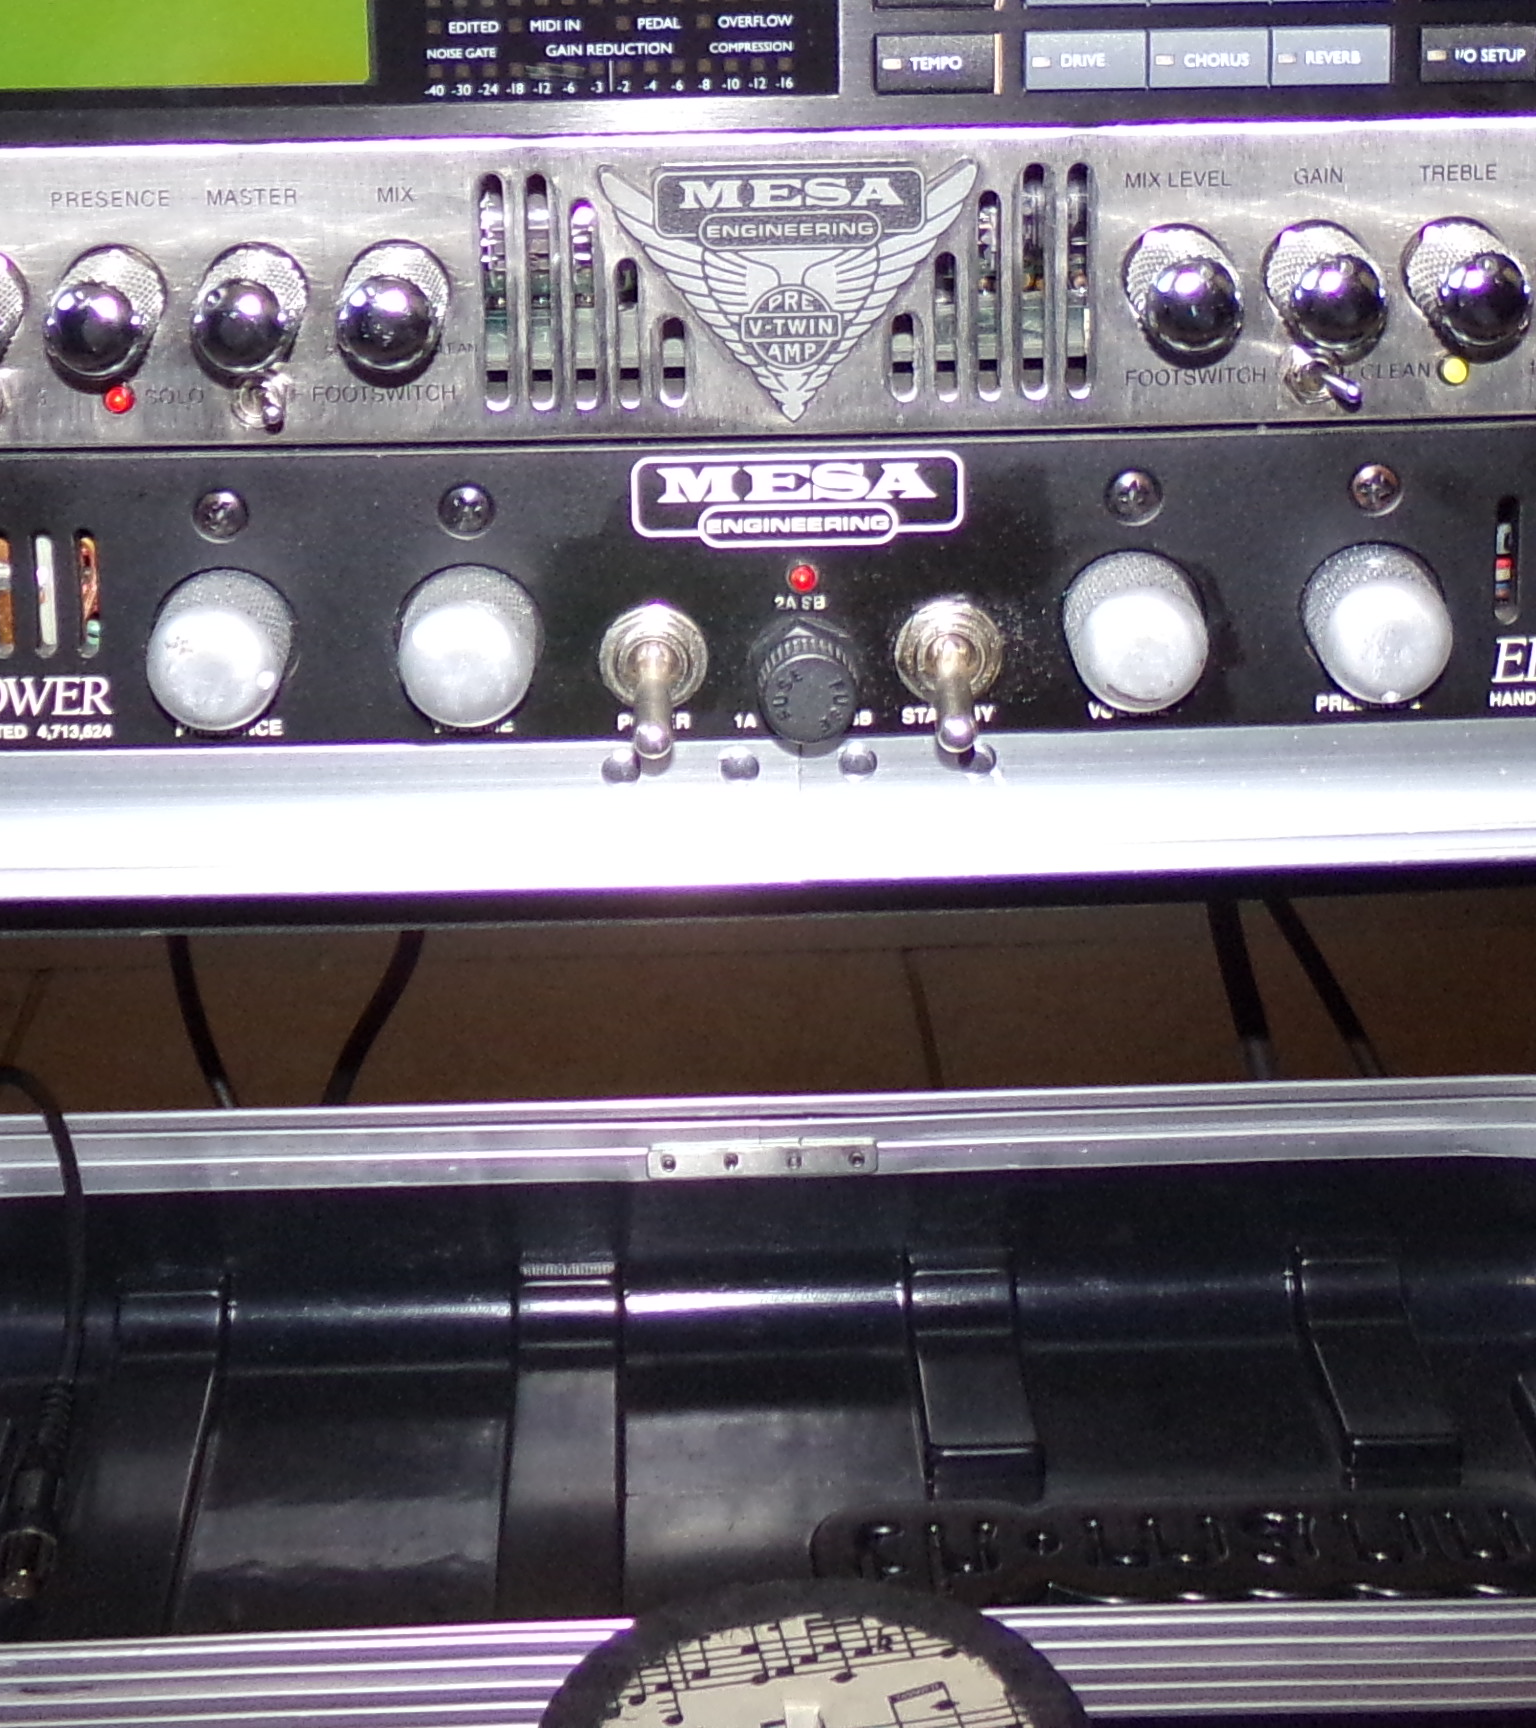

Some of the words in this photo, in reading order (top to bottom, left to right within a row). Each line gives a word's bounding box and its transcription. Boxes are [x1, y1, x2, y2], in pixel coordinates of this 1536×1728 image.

[448, 20, 500, 35] EDITED
[529, 19, 562, 33] MIDI
[564, 18, 581, 32] IN
[637, 17, 682, 31] PEDAL
[717, 14, 793, 29] OVERFLOW
[426, 48, 463, 60] NOISE
[464, 47, 498, 60] GATE
[546, 43, 584, 57] GAIN
[586, 41, 673, 56] REDUCTION
[709, 41, 794, 54] COMPRESSION
[1304, 49, 1361, 66] REVERB
[1480, 48, 1526, 63] SETUP
[909, 55, 962, 71] TEMPO
[1060, 52, 1106, 68] DRIVE
[1183, 52, 1249, 68] CHORUS
[424, 84, 445, 97] -40
[450, 84, 472, 97] -30
[477, 84, 498, 97] -24
[505, 83, 525, 96] -18
[532, 83, 552, 96] -12
[561, 82, 576, 95] -6
[590, 81, 604, 95] -3
[616, 81, 632, 94] -2
[642, 80, 658, 93] -4
[670, 80, 684, 93] -6
[696, 79, 712, 92] -8
[721, 79, 741, 91] -10
[747, 78, 768, 91] -12
[774, 77, 794, 90] -16
[1124, 172, 1160, 188] MIX
[1168, 170, 1232, 187] LEVEL
[1293, 167, 1344, 184] GAIN
[1420, 163, 1497, 181] TREBLE
[50, 190, 169, 208] PRESENCE
[205, 188, 298, 207] MASTER
[376, 186, 414, 204] MIX
[678, 177, 904, 210] MESA
[706, 221, 875, 237] ENGINEERING
[767, 292, 815, 312] PRE
[748, 318, 834, 335] V-TWIN
[767, 341, 817, 363] AMP
[1124, 366, 1267, 388] FOOTSWITCH
[1360, 362, 1431, 380] CLEAN
[145, 386, 205, 406] SOLO
[312, 384, 456, 403] FOOTSWITCH
[656, 462, 937, 504] MESA
[706, 514, 890, 534] ENGINEERING
[774, 595, 797, 610] 2A
[734, 713, 757, 729] 1A
